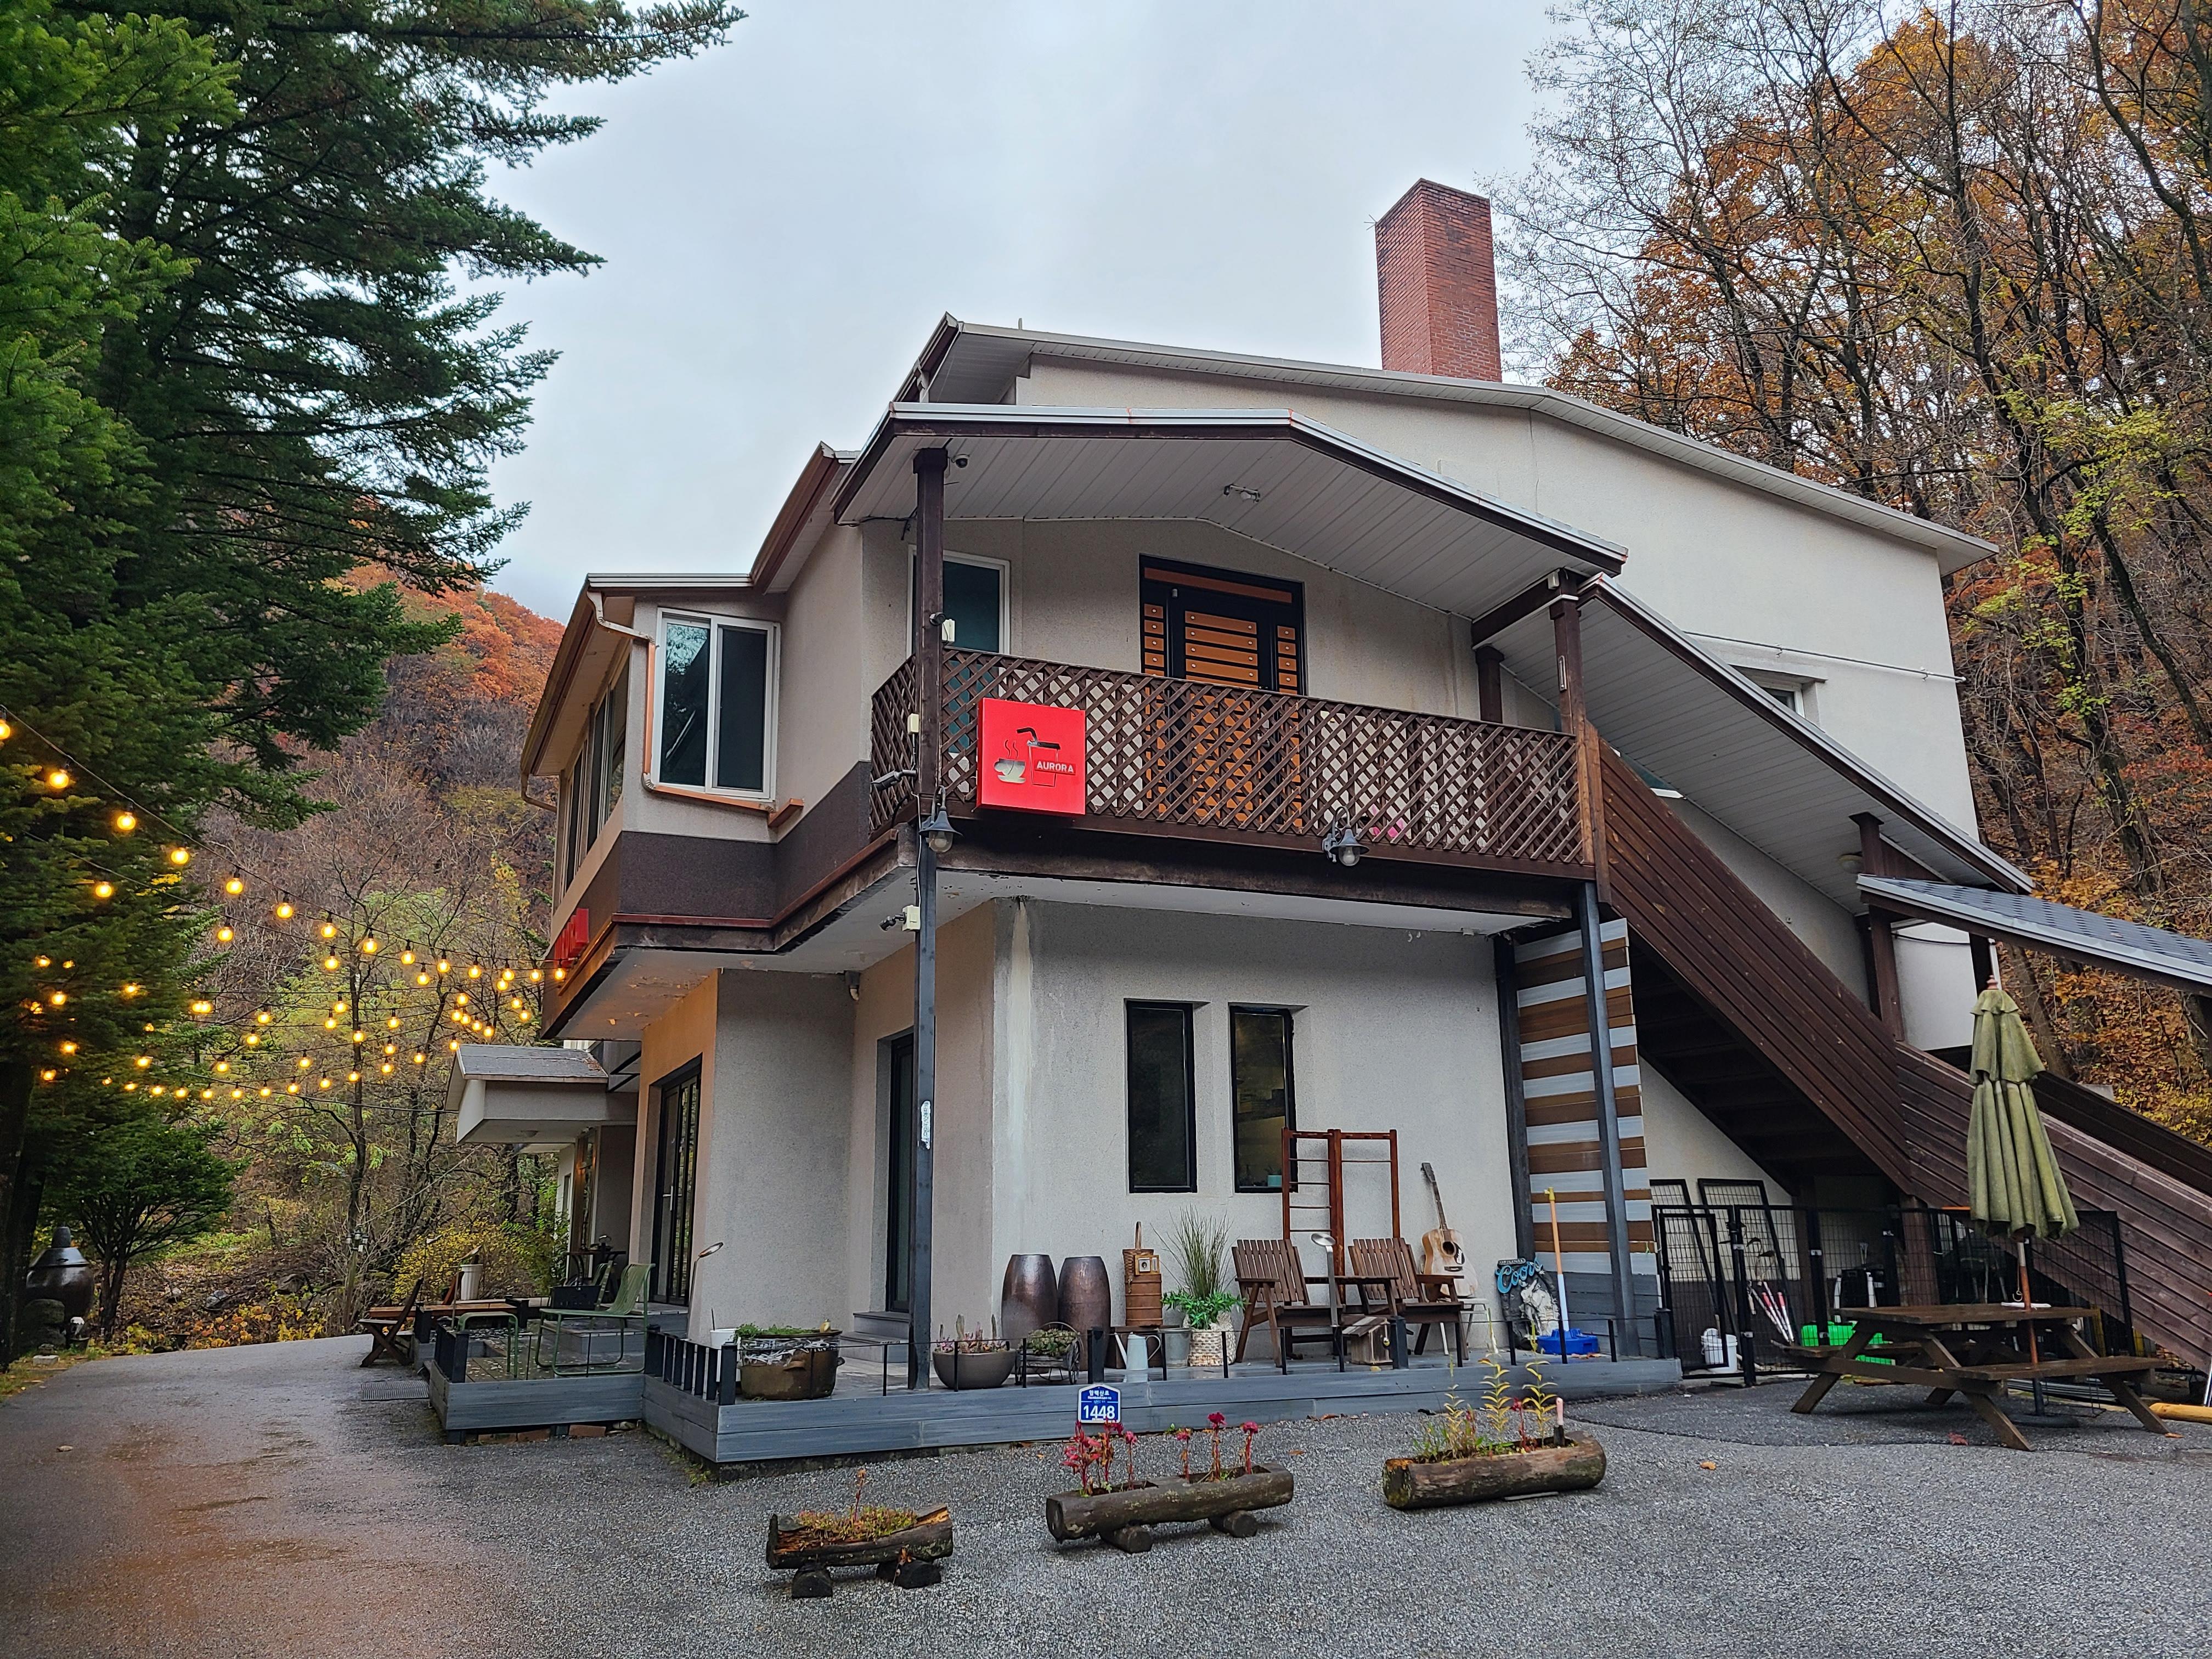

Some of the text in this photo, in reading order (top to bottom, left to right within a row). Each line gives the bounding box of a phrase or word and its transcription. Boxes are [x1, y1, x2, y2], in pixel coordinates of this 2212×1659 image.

[1036, 760, 1074, 773] AURORA
[1495, 1256, 1543, 1294] Coors
[1083, 1405, 1115, 1419] 1448
